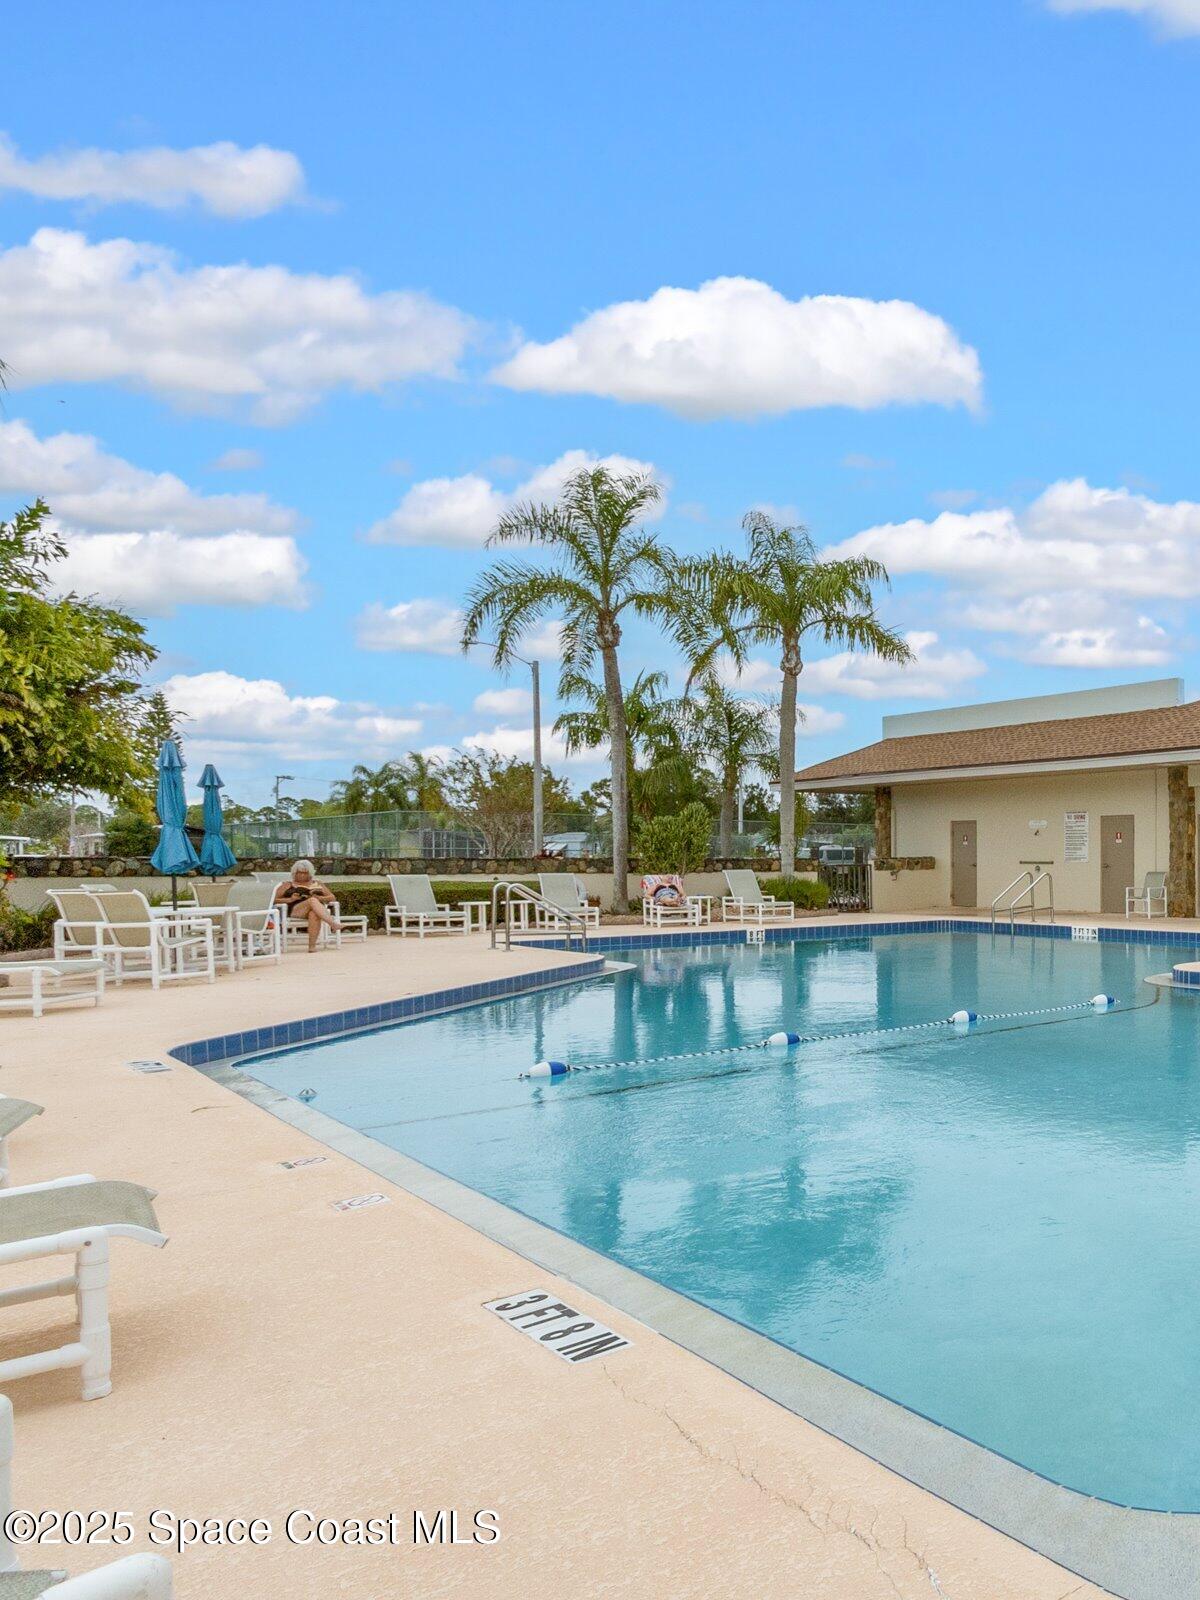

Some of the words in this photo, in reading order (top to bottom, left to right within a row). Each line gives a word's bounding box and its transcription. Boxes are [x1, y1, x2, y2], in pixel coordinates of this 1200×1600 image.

[495, 1294, 548, 1311] 3
[509, 1303, 580, 1329] FT
[539, 1322, 595, 1341] 8
[556, 1331, 628, 1362] IN
